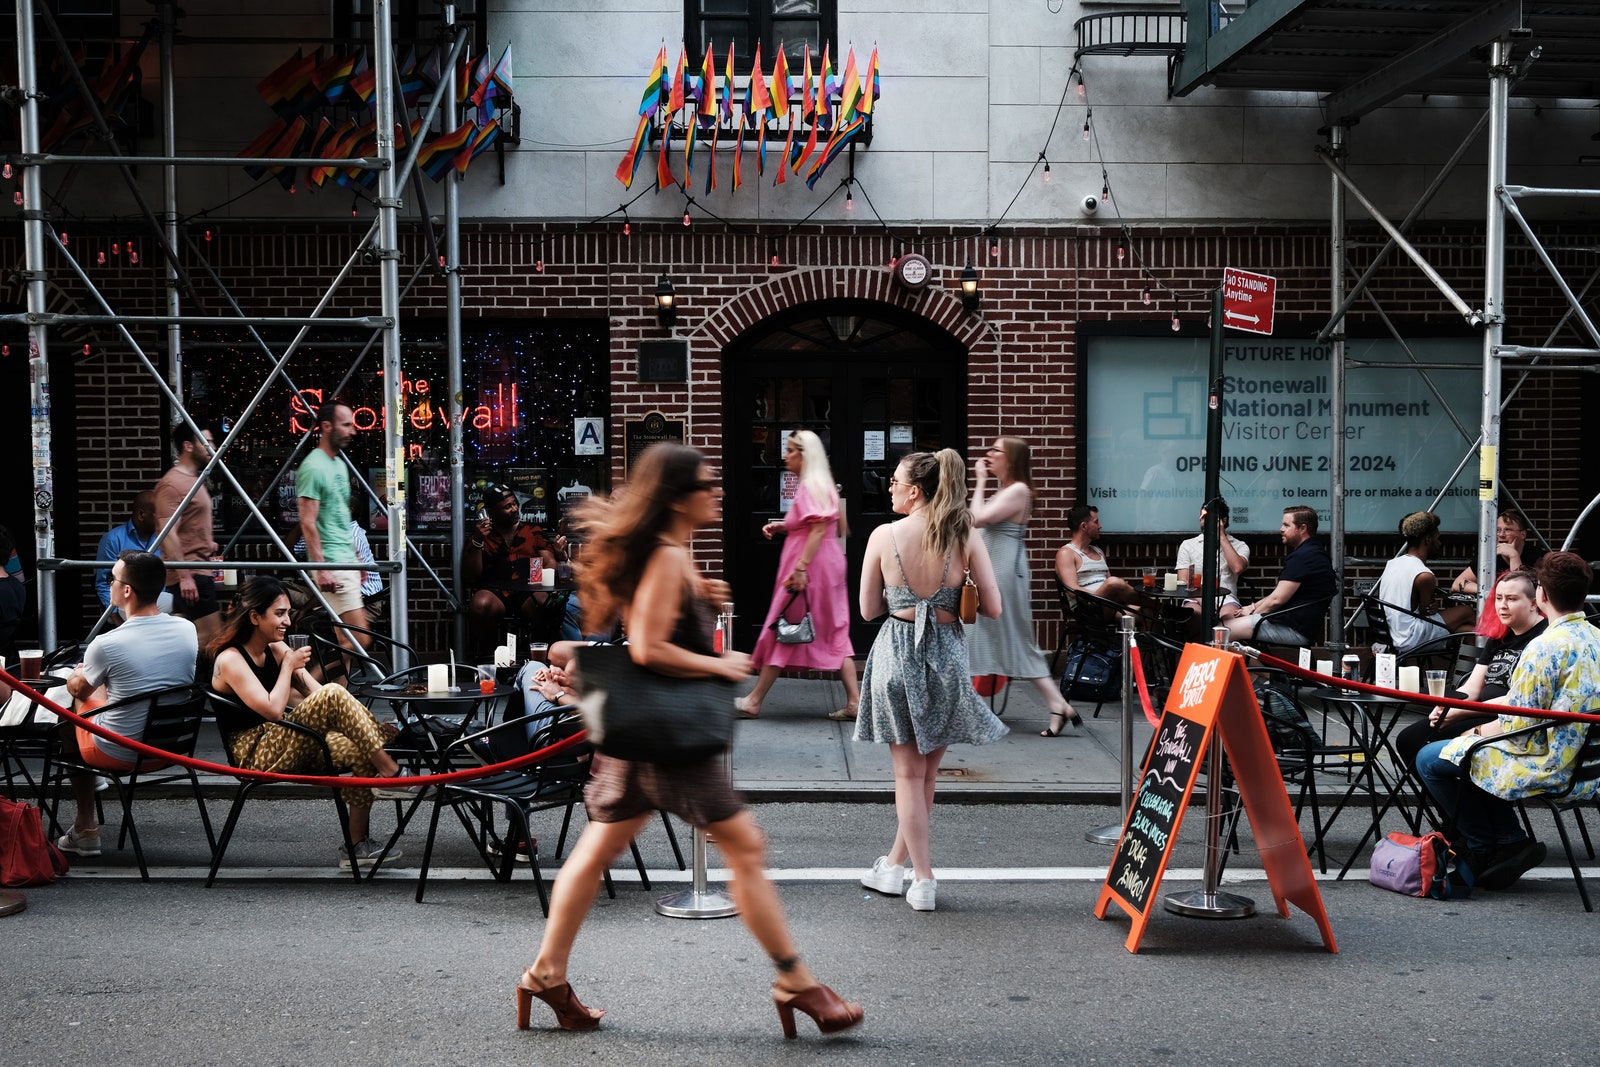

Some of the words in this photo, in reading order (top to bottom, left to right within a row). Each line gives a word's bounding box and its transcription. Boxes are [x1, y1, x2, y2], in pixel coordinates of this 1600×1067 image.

[1227, 274, 1236, 286] NO
[1237, 277, 1268, 292] STANDING
[1226, 288, 1253, 303] Anytime
[1224, 347, 1295, 361] FUTURE
[377, 371, 430, 393] he
[1222, 376, 1327, 394] Stonewall
[290, 383, 517, 434] Soewall
[1223, 399, 1312, 417] National
[1318, 399, 1430, 417] Mnument
[579, 422, 600, 445] A
[1222, 421, 1290, 440] Visitor
[1296, 421, 1365, 440] Cener
[1262, 456, 1313, 472] JUNE
[1350, 456, 1396, 472] 2024
[1090, 487, 1117, 499] Visit
[1120, 487, 1279, 501] stonewallvisitenter.org
[1282, 488, 1295, 498] to
[1297, 487, 1328, 498] learn
[1365, 489, 1378, 498] or
[1380, 487, 1412, 498] make
[1415, 489, 1423, 498] a
[1179, 657, 1221, 695] APEROL
[1179, 685, 1207, 709] SPRITZ
[1174, 719, 1188, 738] THE
[1156, 727, 1191, 763] STONEWALL
[1163, 759, 1177, 774] INN
[1140, 790, 1174, 823] CELEBRATING
[1131, 810, 1150, 834] BLACK
[1147, 827, 1167, 852] VOICES
[1127, 838, 1148, 869] DRAG
[1116, 862, 1151, 902] BINGO!
